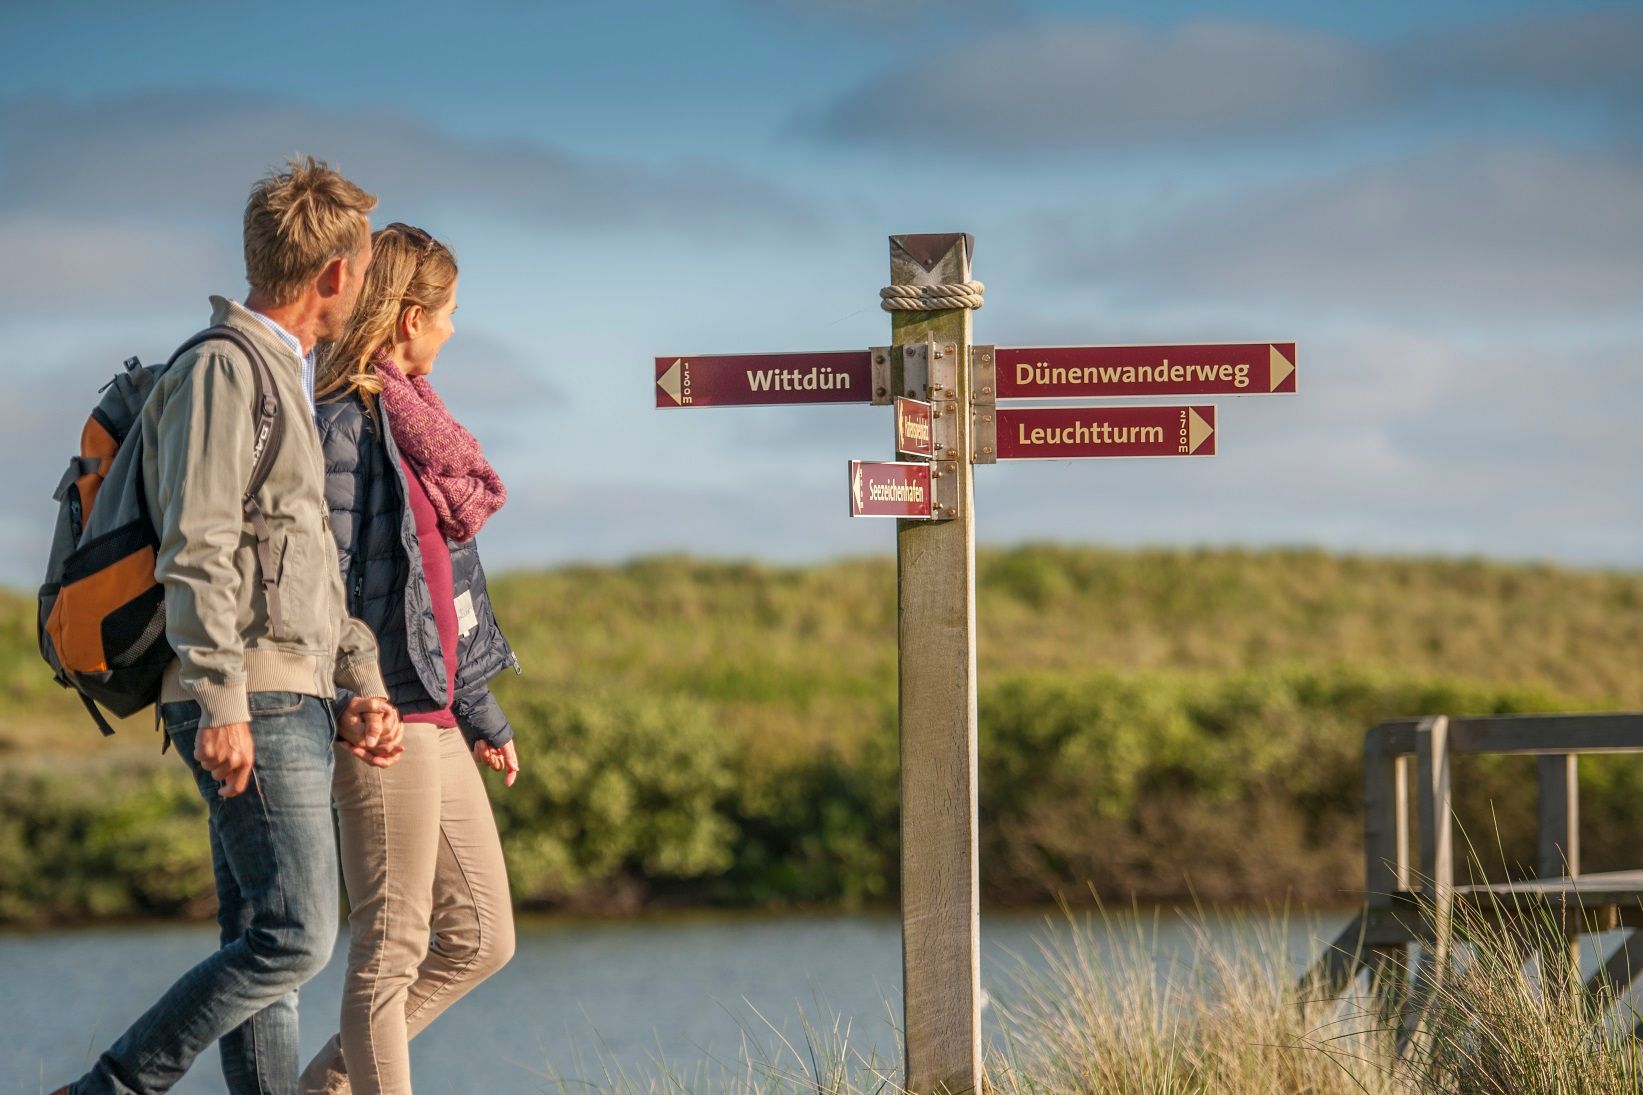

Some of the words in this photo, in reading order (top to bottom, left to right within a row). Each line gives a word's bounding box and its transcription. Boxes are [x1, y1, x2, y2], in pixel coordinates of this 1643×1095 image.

[747, 367, 850, 391] Wittdün
[1016, 360, 1249, 387] Dünenwanderweg
[1019, 421, 1163, 445] Leuchtturm
[869, 478, 924, 503] Seezeichenhafen
